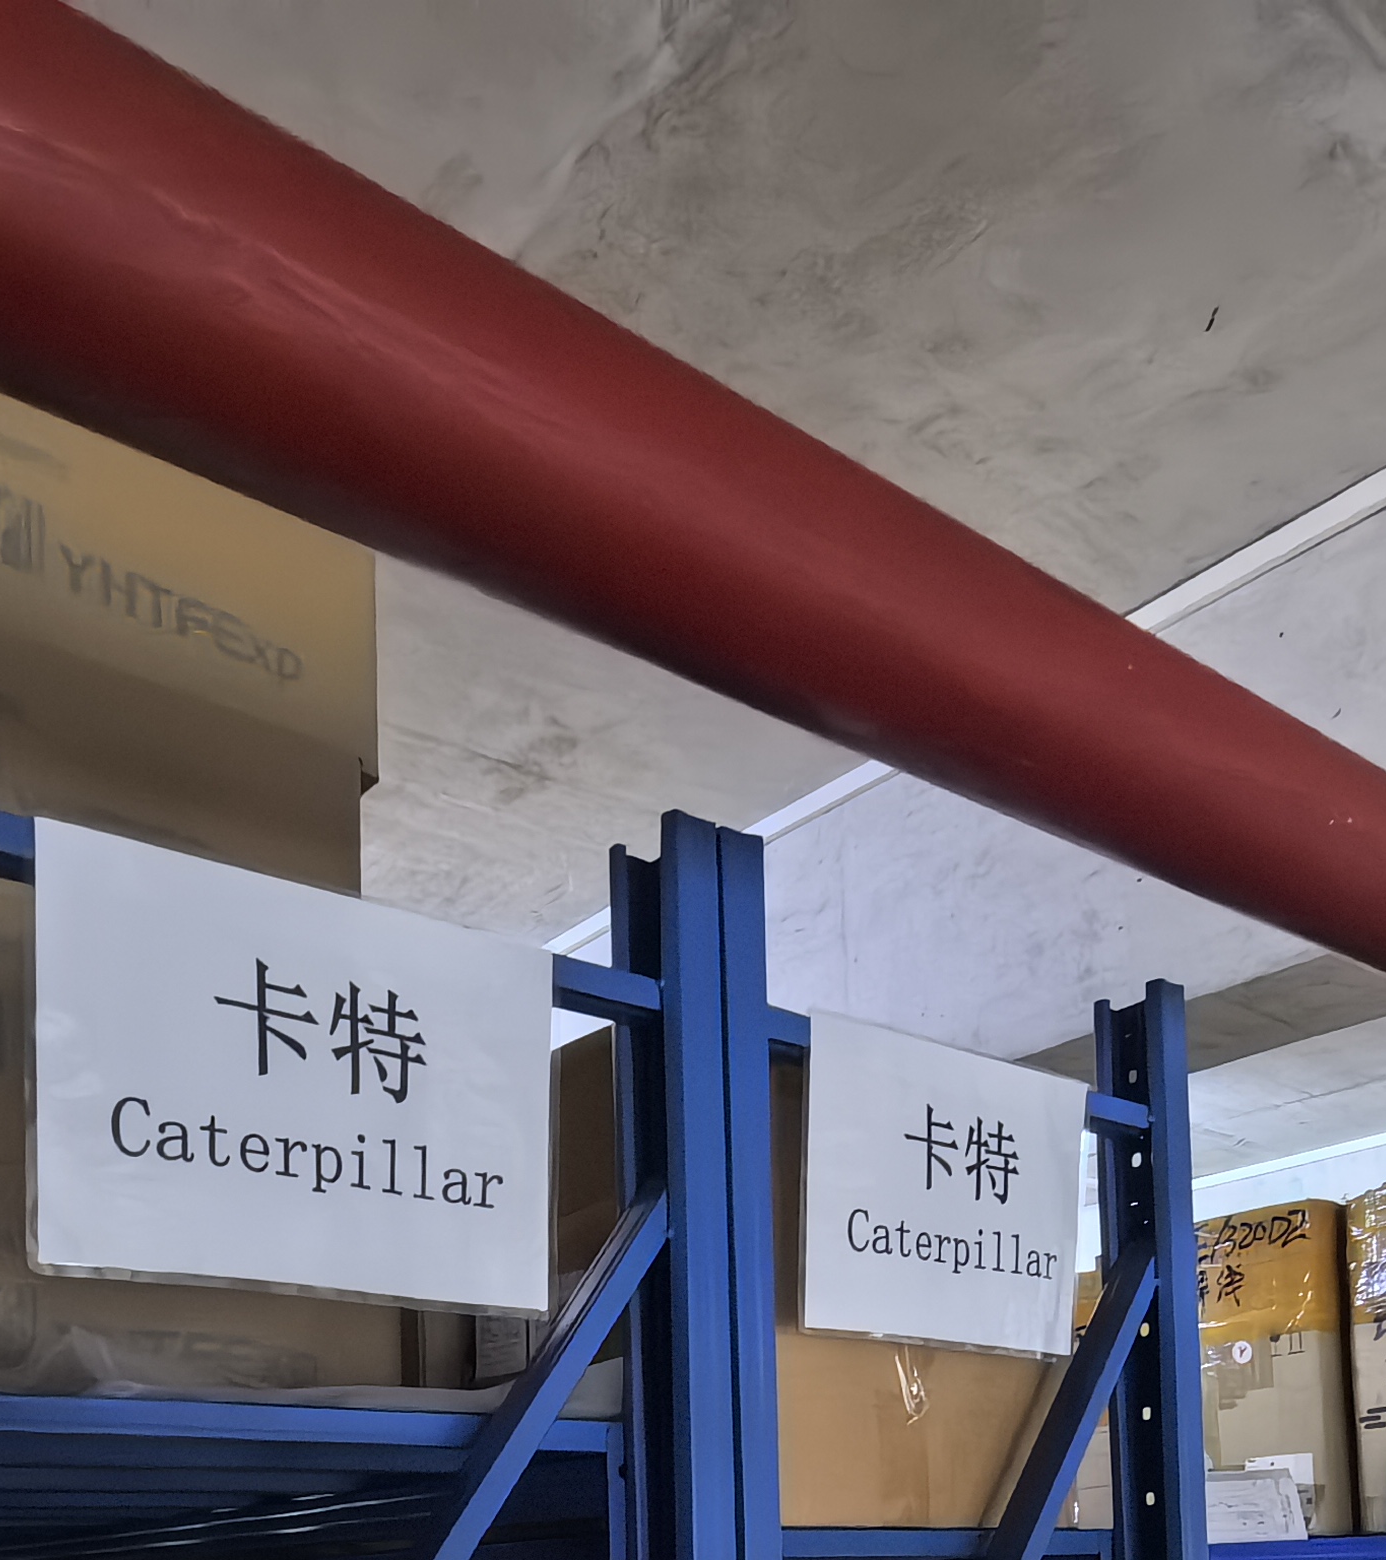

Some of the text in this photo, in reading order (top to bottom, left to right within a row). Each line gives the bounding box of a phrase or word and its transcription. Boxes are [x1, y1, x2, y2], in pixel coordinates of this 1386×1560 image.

[214, 958, 426, 1103] 卡特
[111, 1096, 505, 1211] Caterpillar
[903, 1103, 1021, 1206] 卡特
[846, 1208, 1059, 1282] Caterpillar
